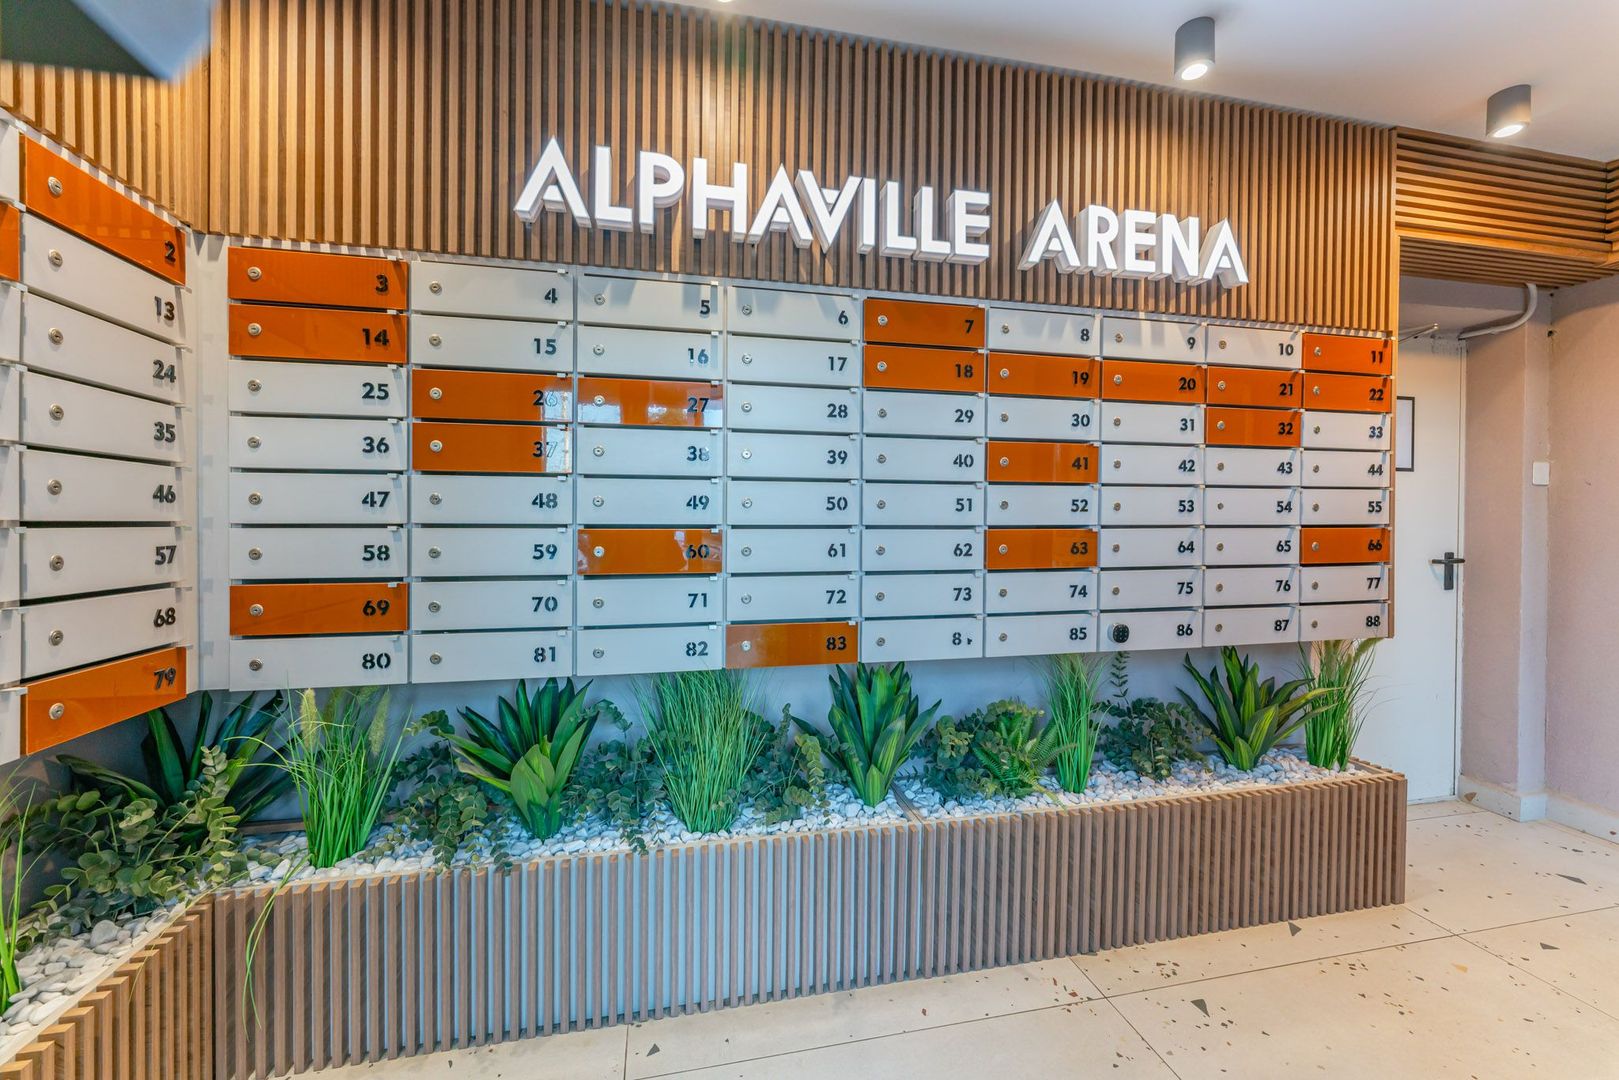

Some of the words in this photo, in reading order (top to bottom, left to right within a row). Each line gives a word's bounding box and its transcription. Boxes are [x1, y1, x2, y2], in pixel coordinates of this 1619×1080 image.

[513, 136, 990, 265] ALPHAVILLE
[1018, 199, 1249, 289] ARENA
[165, 240, 175, 262] 2
[376, 275, 388, 292] 3
[544, 288, 558, 304] 4
[154, 296, 175, 320] 13
[700, 300, 710, 315] 5
[838, 311, 848, 325] 6
[965, 320, 974, 334] 7
[362, 328, 389, 346] 14
[1080, 329, 1090, 341] 8
[533, 338, 556, 355] 15
[1187, 337, 1195, 349] 9
[1278, 343, 1293, 356] 10
[688, 348, 709, 365] 16
[828, 356, 847, 371] 17
[1371, 351, 1383, 364] 11
[152, 360, 176, 383] 24
[955, 364, 973, 378] 18
[1072, 371, 1089, 384] 19
[1178, 377, 1196, 390] 20
[1279, 383, 1293, 396] 21
[362, 383, 389, 400] 25
[533, 390, 558, 407] 26
[1369, 389, 1383, 401] 22
[687, 398, 709, 413] 27
[827, 404, 848, 418] 28
[955, 409, 974, 423] 29
[1071, 414, 1090, 427] 30
[1180, 418, 1195, 431] 31
[1278, 423, 1293, 435] 32
[153, 422, 176, 443] 35
[1369, 426, 1383, 438] 33
[362, 436, 389, 453] 36
[533, 441, 558, 458] 37
[686, 446, 710, 462] 38
[827, 450, 848, 465] 39
[953, 454, 974, 467] 40
[1072, 457, 1089, 470] 41
[1178, 460, 1195, 472] 42
[1277, 462, 1293, 474] 43
[1368, 464, 1383, 476] 44
[153, 484, 176, 503] 46
[362, 492, 390, 508] 47
[532, 493, 558, 509] 48
[686, 495, 709, 510] 49
[826, 497, 848, 511] 50
[955, 498, 972, 512] 51
[1071, 499, 1088, 512] 52
[1178, 500, 1194, 513] 53
[1276, 501, 1292, 513] 54
[1368, 501, 1382, 513] 55
[362, 544, 390, 561] 58
[533, 544, 557, 560] 59
[686, 544, 710, 559] 60
[828, 543, 846, 558] 61
[953, 543, 973, 557] 62
[1071, 542, 1088, 555] 63
[1178, 541, 1194, 553] 64
[1276, 540, 1291, 552] 65
[1368, 540, 1382, 551] 66
[155, 545, 176, 565] 57
[1177, 582, 1193, 594] 75
[1275, 580, 1291, 592] 76
[1367, 578, 1381, 589] 77
[826, 590, 847, 604] 72
[953, 587, 972, 601] 73
[1069, 585, 1088, 598] 74
[532, 596, 558, 612] 70
[688, 593, 708, 608] 71
[362, 600, 390, 616] 69
[153, 607, 176, 628] 68
[1366, 616, 1381, 628] 88
[1176, 624, 1193, 636] 86
[1274, 620, 1289, 632] 87
[1069, 628, 1087, 640] 85
[686, 641, 708, 657] 82
[826, 636, 847, 650] 83
[361, 653, 391, 669] 80
[534, 647, 556, 663] 81
[154, 667, 176, 689] 79
